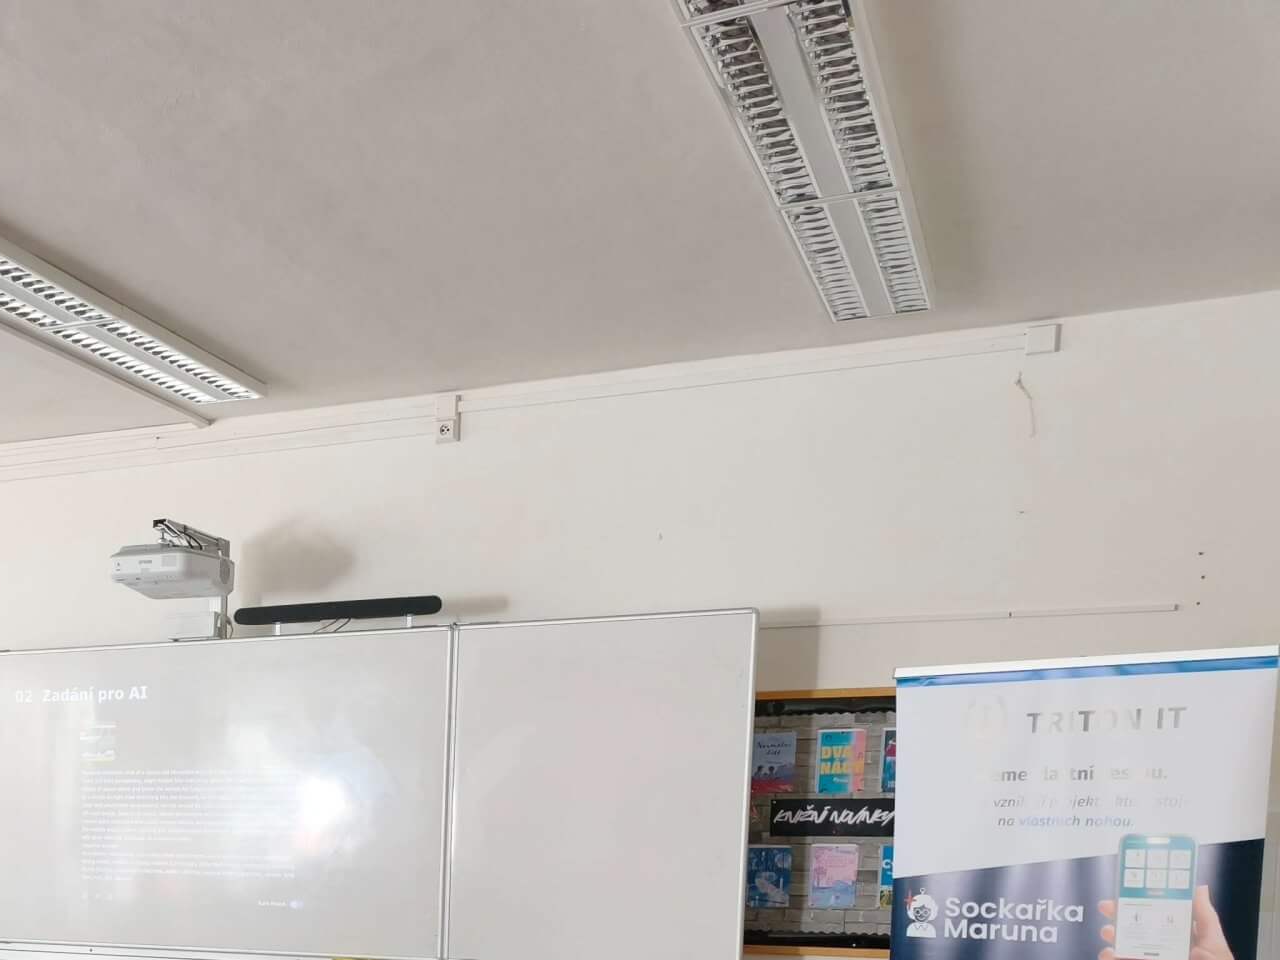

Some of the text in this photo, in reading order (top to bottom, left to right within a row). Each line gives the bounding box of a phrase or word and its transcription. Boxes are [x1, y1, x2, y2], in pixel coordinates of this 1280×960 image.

[15, 686, 148, 704] 02 Zadání pro AI
[1157, 706, 1187, 730] IT
[998, 816, 1015, 827] na
[944, 896, 1084, 923] Sockařka
[944, 918, 1058, 944] Maruna
